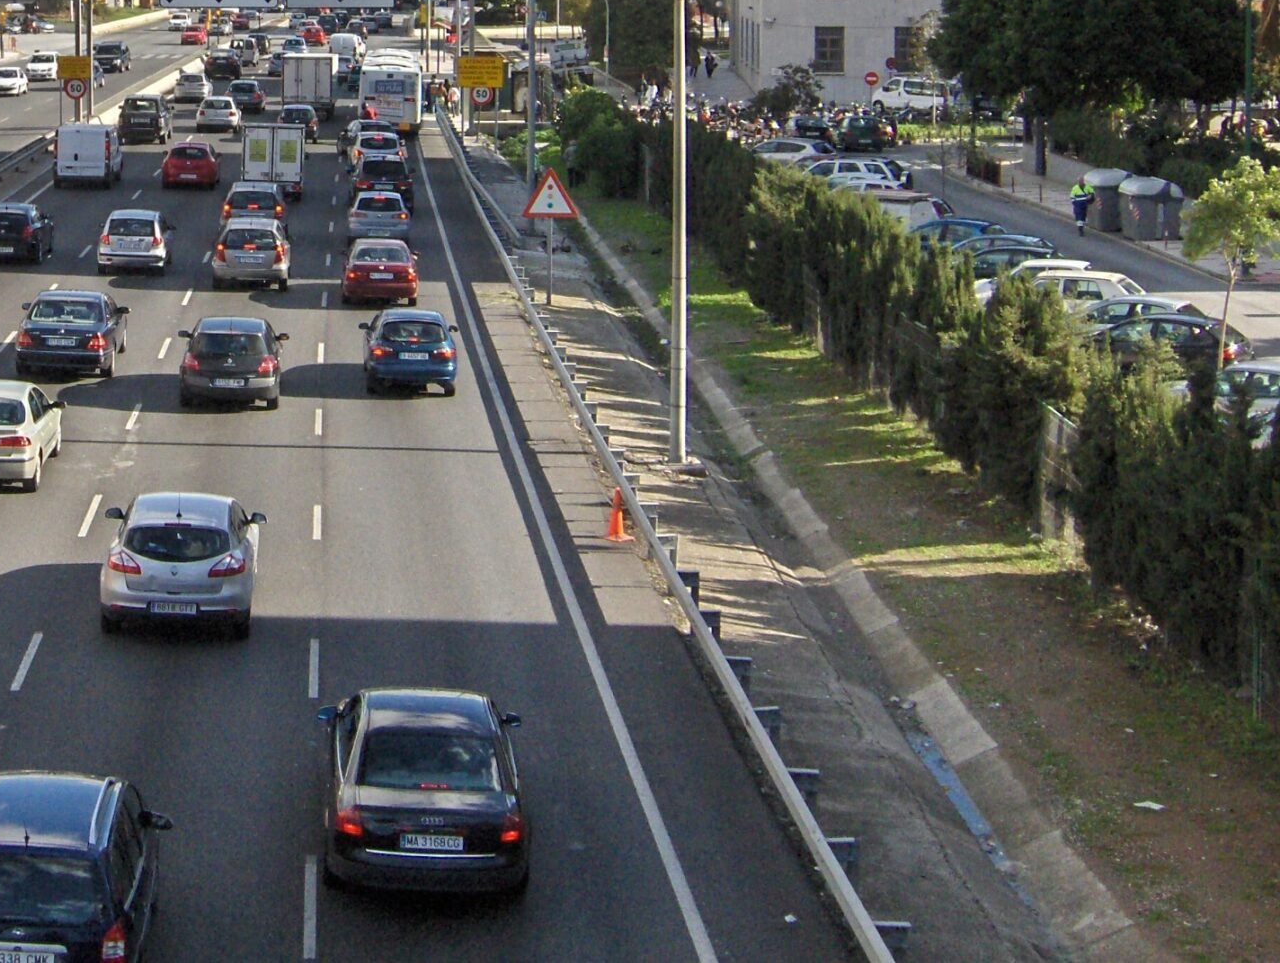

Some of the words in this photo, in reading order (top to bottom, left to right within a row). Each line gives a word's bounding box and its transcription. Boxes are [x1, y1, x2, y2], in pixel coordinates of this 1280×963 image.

[70, 84, 82, 93] 50
[476, 89, 488, 98] 50
[406, 836, 419, 846] MA
